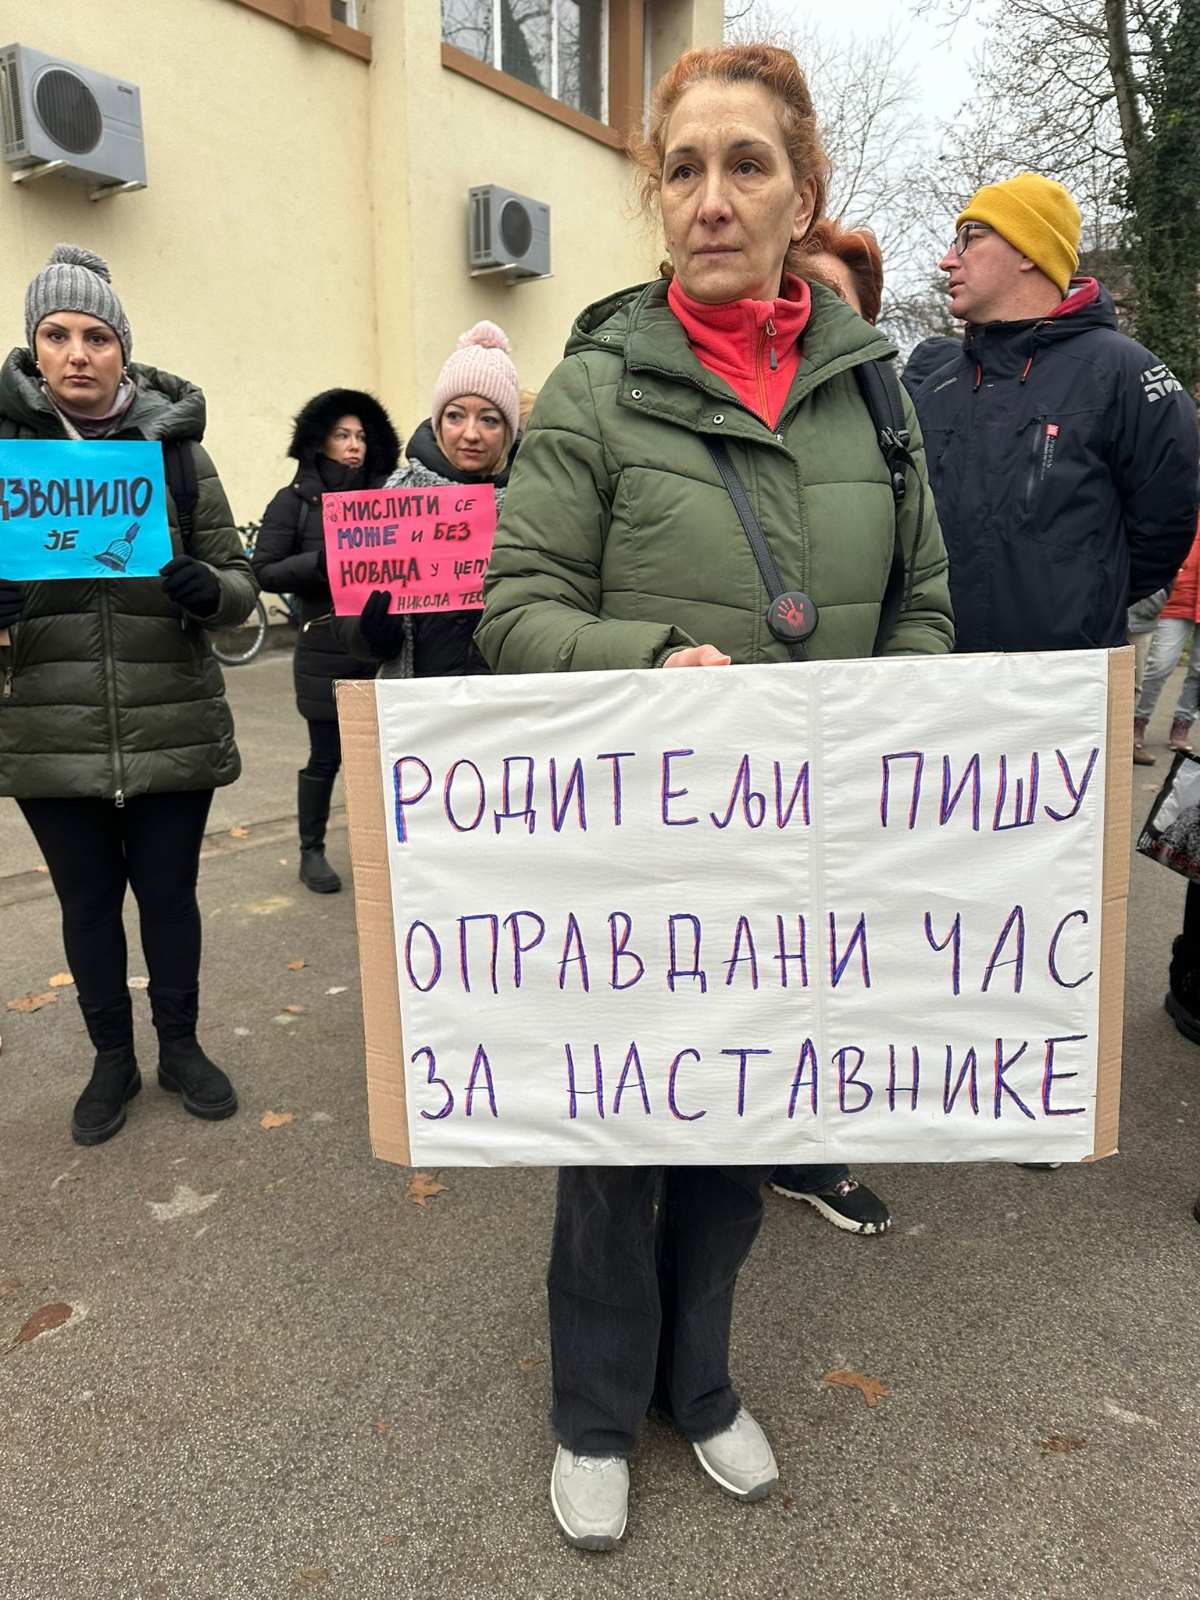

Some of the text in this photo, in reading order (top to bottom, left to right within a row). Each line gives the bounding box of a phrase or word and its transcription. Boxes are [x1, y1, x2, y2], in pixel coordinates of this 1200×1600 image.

[342, 495, 477, 522] МИСЛИТИ СЕ
[44, 529, 80, 550] ЈЕ
[337, 524, 400, 549] МОЖЕ
[434, 522, 471, 541] БЕЗ
[341, 557, 422, 588] НОВАЦА
[397, 590, 484, 611] НИКОЛА ТЕС
[392, 746, 1100, 843] РОДИТЕЉИ ПИШУ
[405, 905, 1094, 995] ОПРАВДАНИ ЧАС
[411, 1034, 1088, 1121] ЗА НАСТАВНИКЕ
